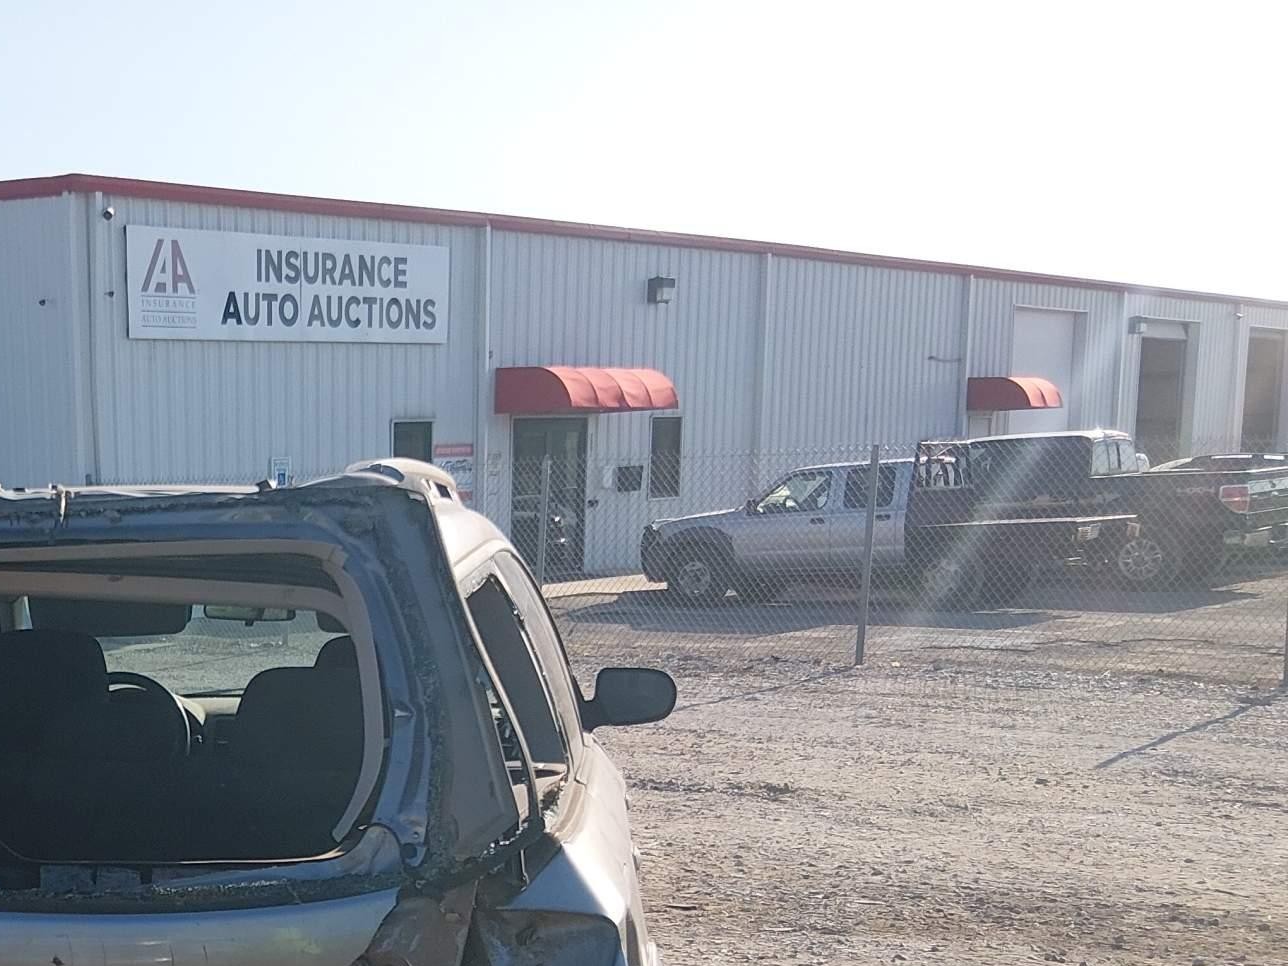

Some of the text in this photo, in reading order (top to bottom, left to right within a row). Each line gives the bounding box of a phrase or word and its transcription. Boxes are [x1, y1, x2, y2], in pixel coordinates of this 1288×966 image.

[256, 248, 408, 289] INSURANCE
[221, 291, 437, 331] AUTO AUCTIONS
